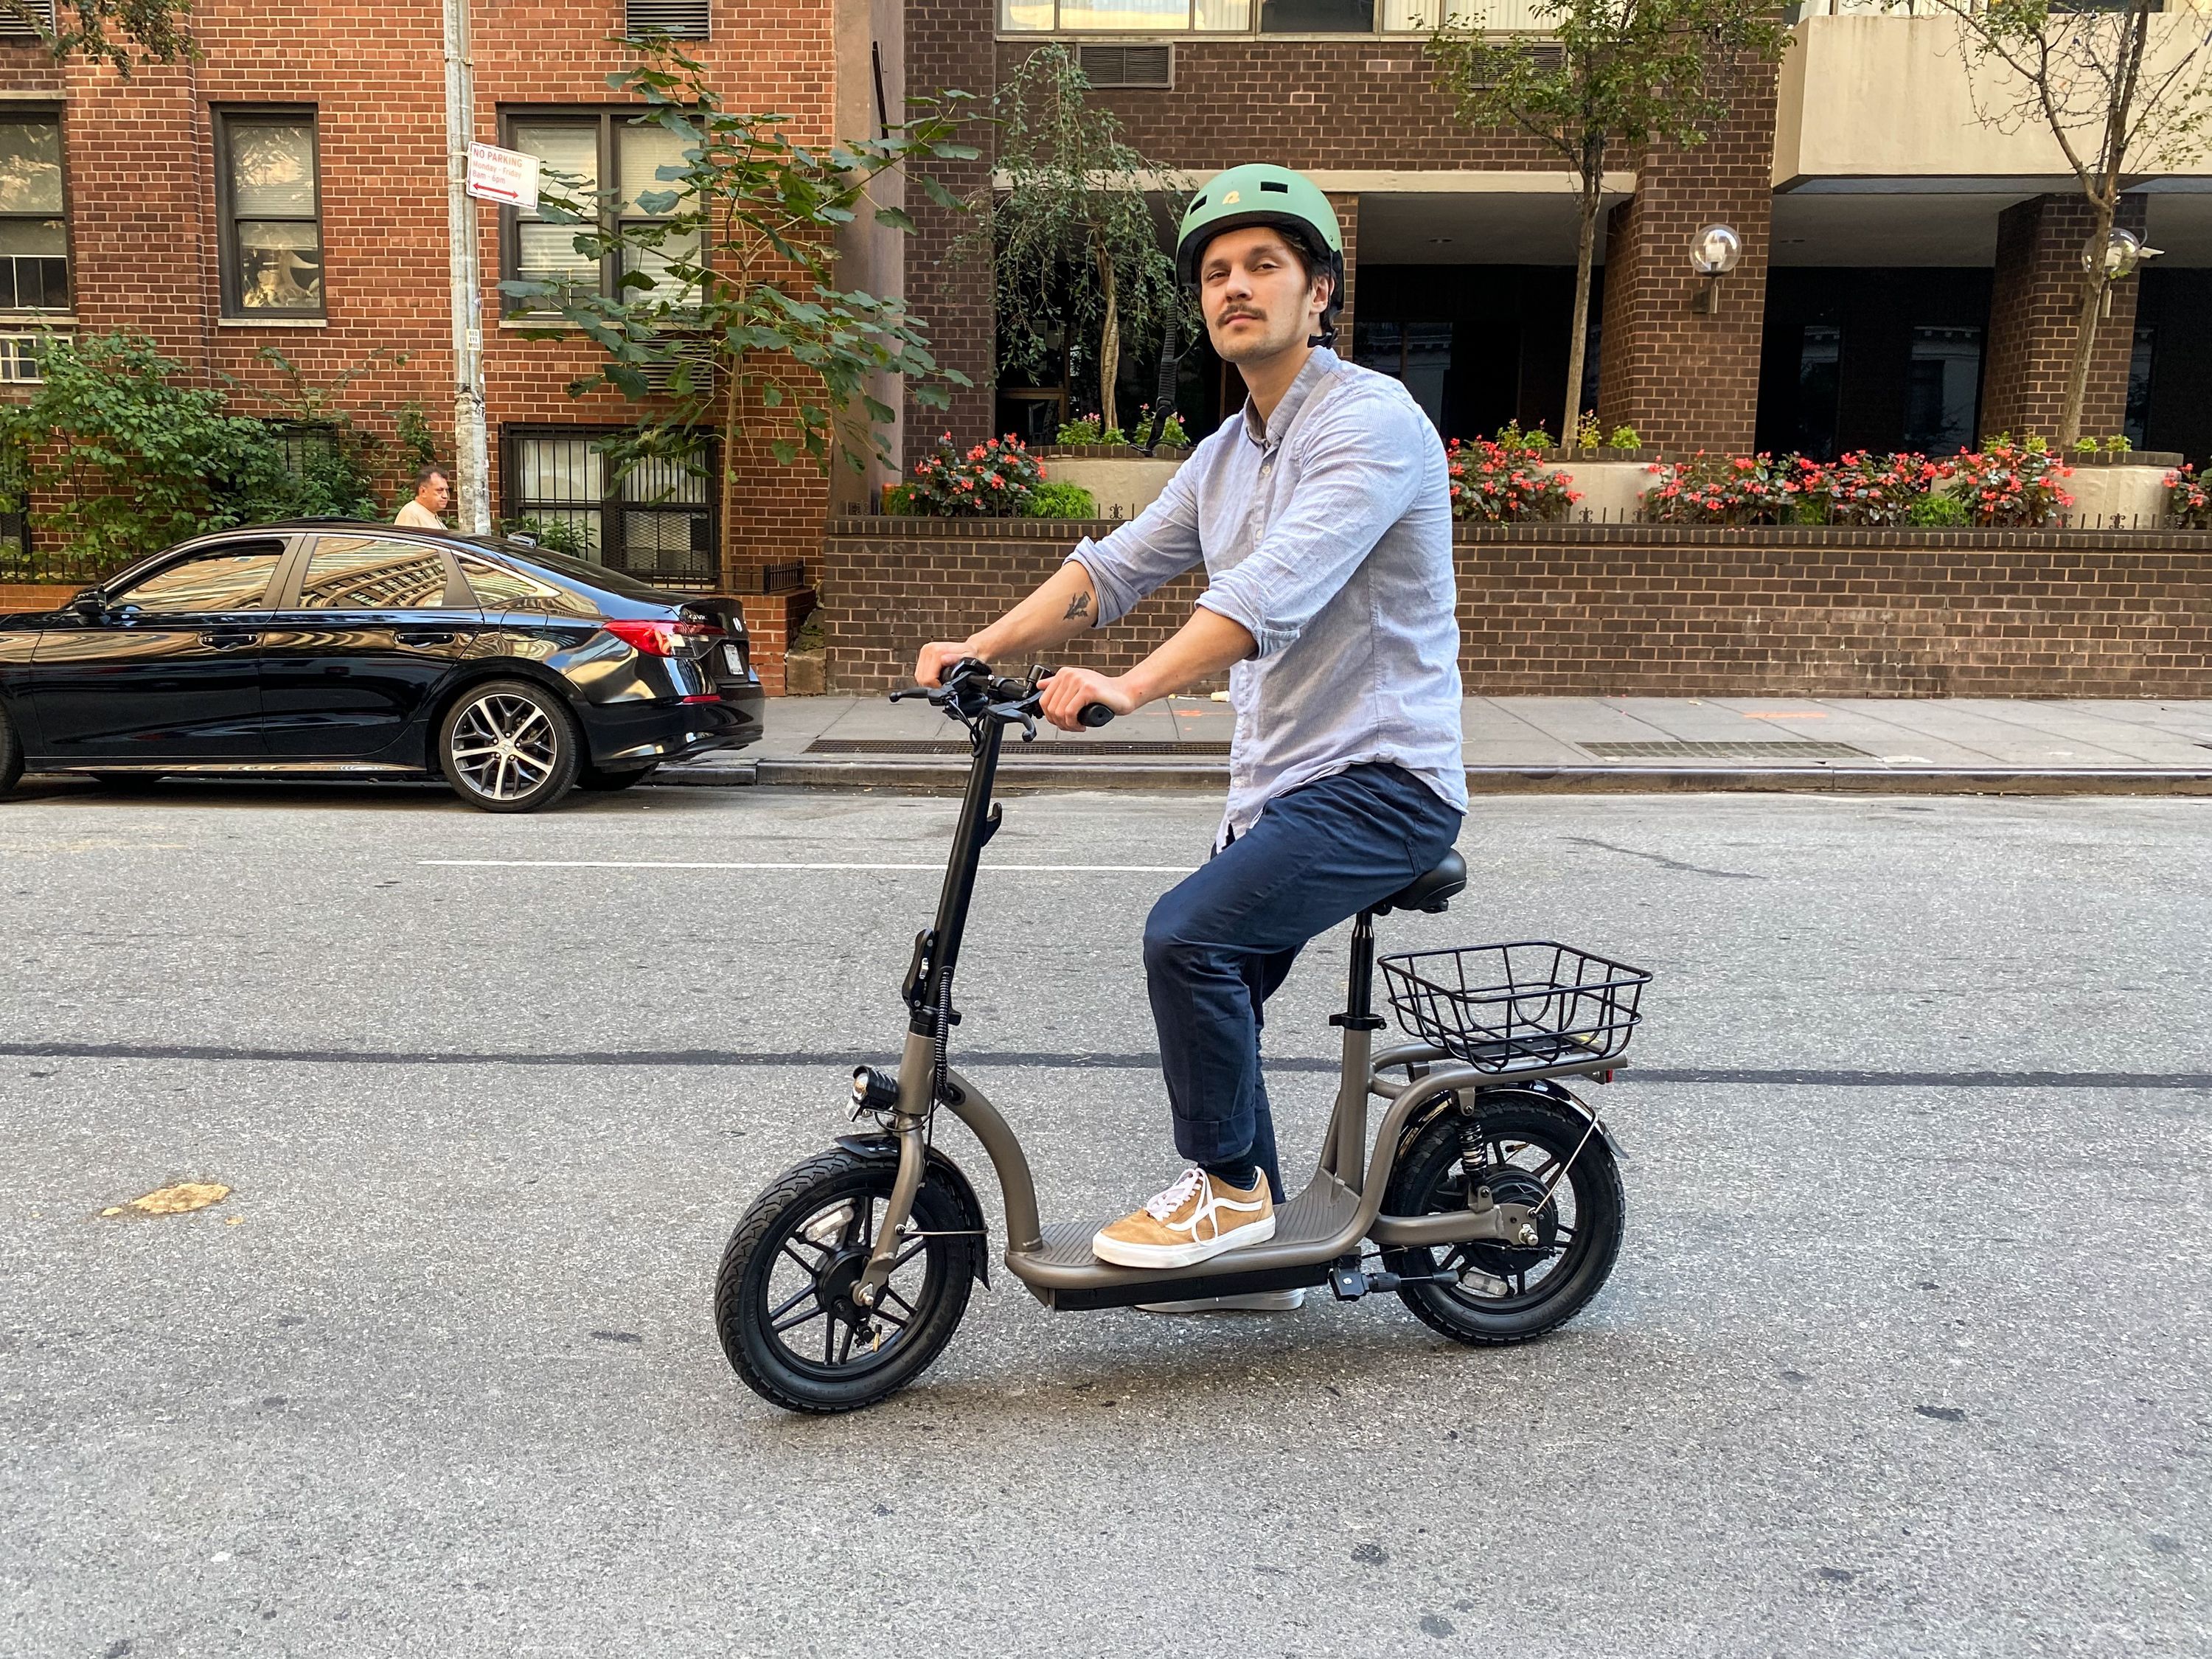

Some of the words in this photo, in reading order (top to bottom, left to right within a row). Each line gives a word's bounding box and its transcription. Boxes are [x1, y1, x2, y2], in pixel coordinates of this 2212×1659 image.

[473, 147, 485, 159] NO
[487, 151, 523, 168] PARKING
[472, 170, 486, 179] 8am
[492, 175, 506, 184] 6pm
[473, 161, 497, 173] Monday
[503, 167, 522, 179] Friday
